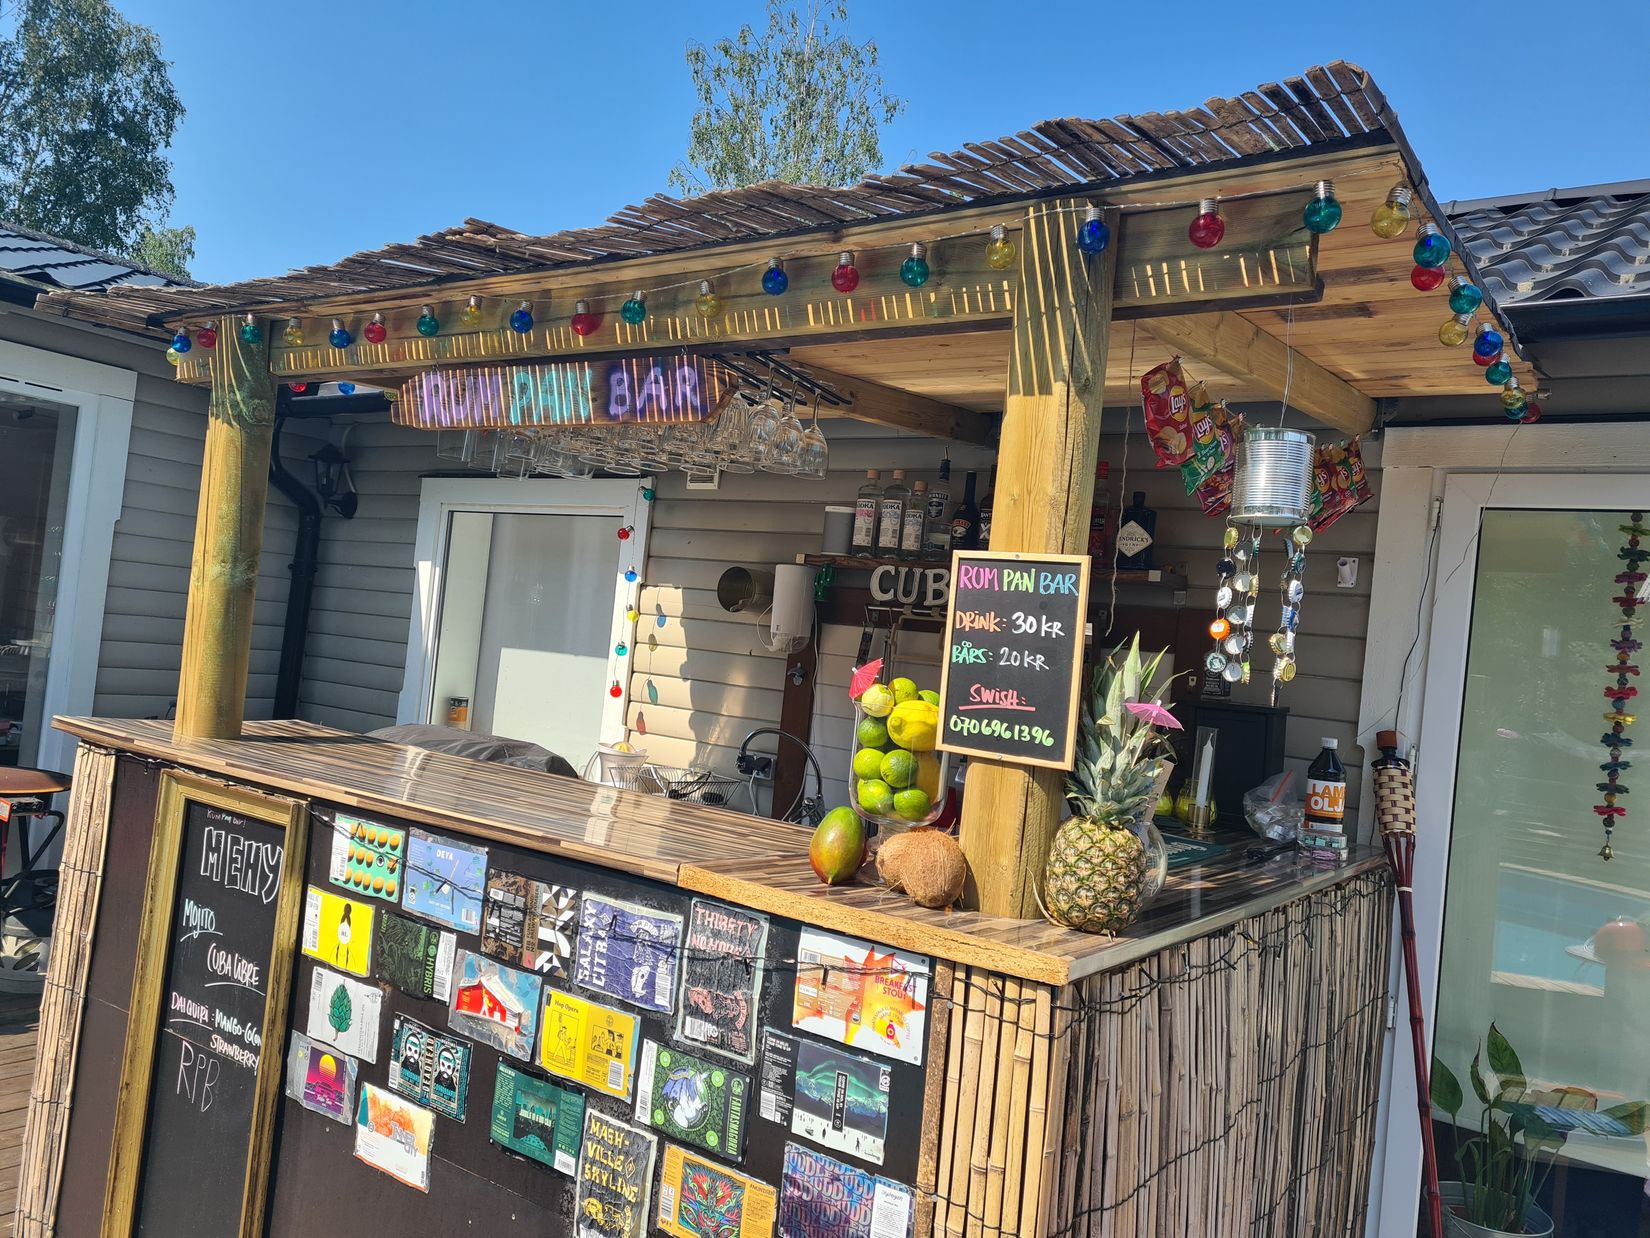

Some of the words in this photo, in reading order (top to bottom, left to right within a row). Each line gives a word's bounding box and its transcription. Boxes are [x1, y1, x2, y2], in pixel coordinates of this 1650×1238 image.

[508, 369, 592, 425] PAN
[608, 366, 698, 416] BAR
[1120, 536, 1149, 544] ENDRICK'S
[1003, 568, 1036, 593] PAN
[1039, 572, 1079, 596] BAR
[1012, 611, 1037, 634] 30
[999, 646, 1020, 667] 20
[695, 906, 759, 939] THIRSTY
[207, 943, 232, 977] CUBA
[424, 957, 434, 994] HYBRIS
[554, 999, 564, 1009] Hop
[565, 1002, 579, 1014] Opera
[883, 986, 907, 1000] STOUT
[177, 1040, 220, 1112] RPB
[422, 1037, 435, 1092] DEADHEAD
[587, 1141, 625, 1172] VILLE
[584, 1163, 639, 1204] SKYLINE
